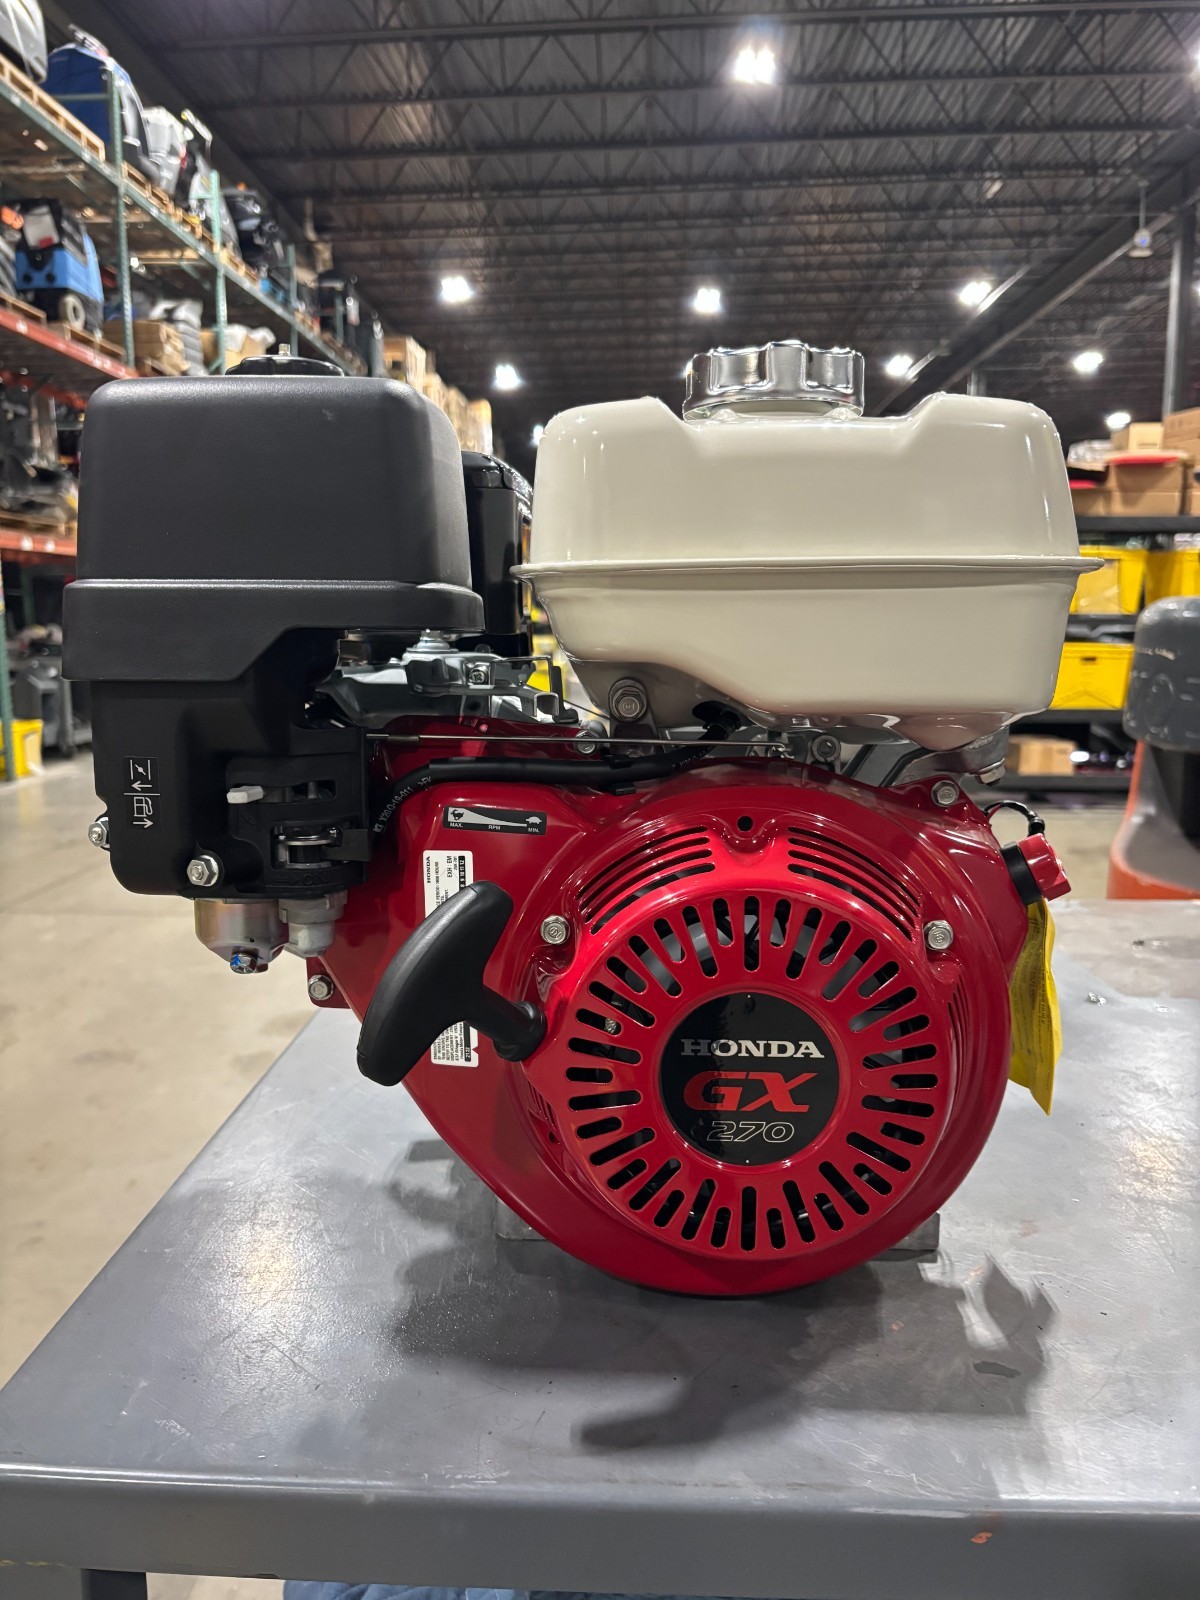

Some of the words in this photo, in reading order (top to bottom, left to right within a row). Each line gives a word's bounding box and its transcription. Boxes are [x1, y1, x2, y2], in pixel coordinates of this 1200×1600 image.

[447, 855, 452, 864] EM
[680, 1039, 825, 1059] HONDA
[683, 1070, 819, 1113] GX
[707, 1121, 795, 1143] 270
